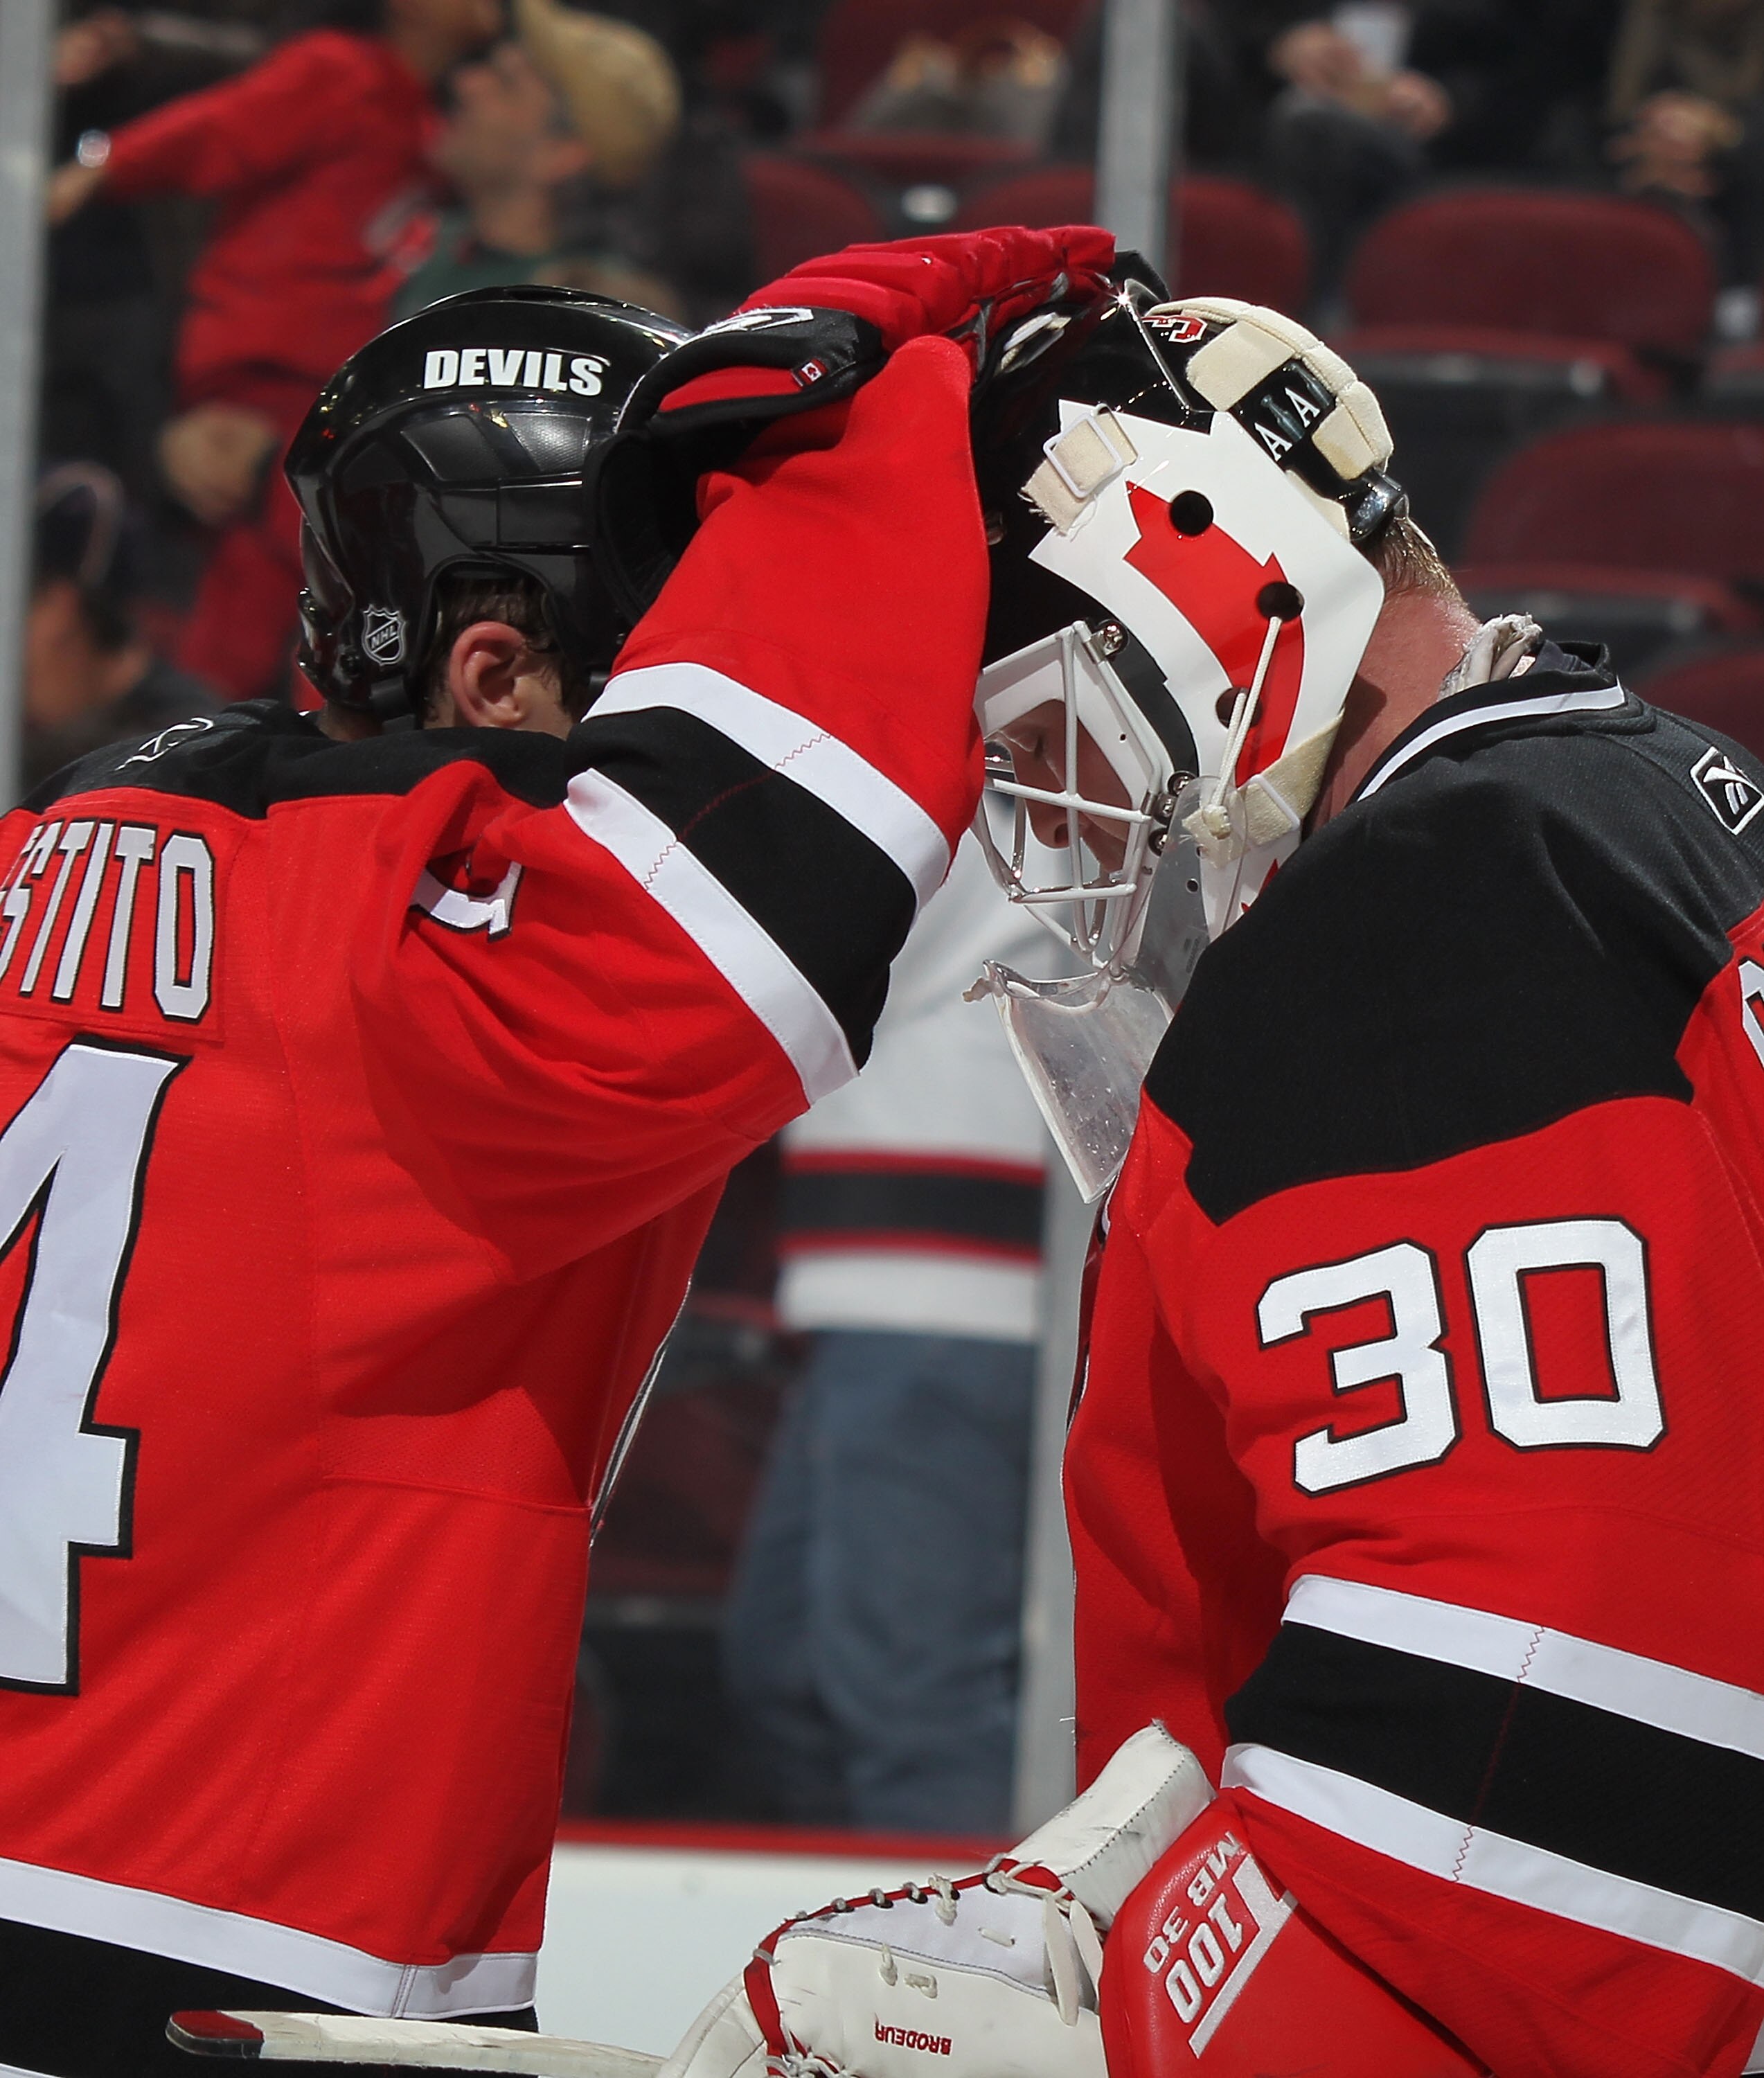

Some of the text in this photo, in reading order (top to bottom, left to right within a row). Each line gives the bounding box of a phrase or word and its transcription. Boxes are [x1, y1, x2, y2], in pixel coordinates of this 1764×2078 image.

[424, 348, 603, 396] DEVILS
[1254, 387, 1321, 462] A A
[371, 625, 398, 650] NHL
[1254, 1214, 1669, 1498] 30
[1143, 1831, 1242, 1973] MB 30
[875, 2018, 952, 2056] BRODEUR
